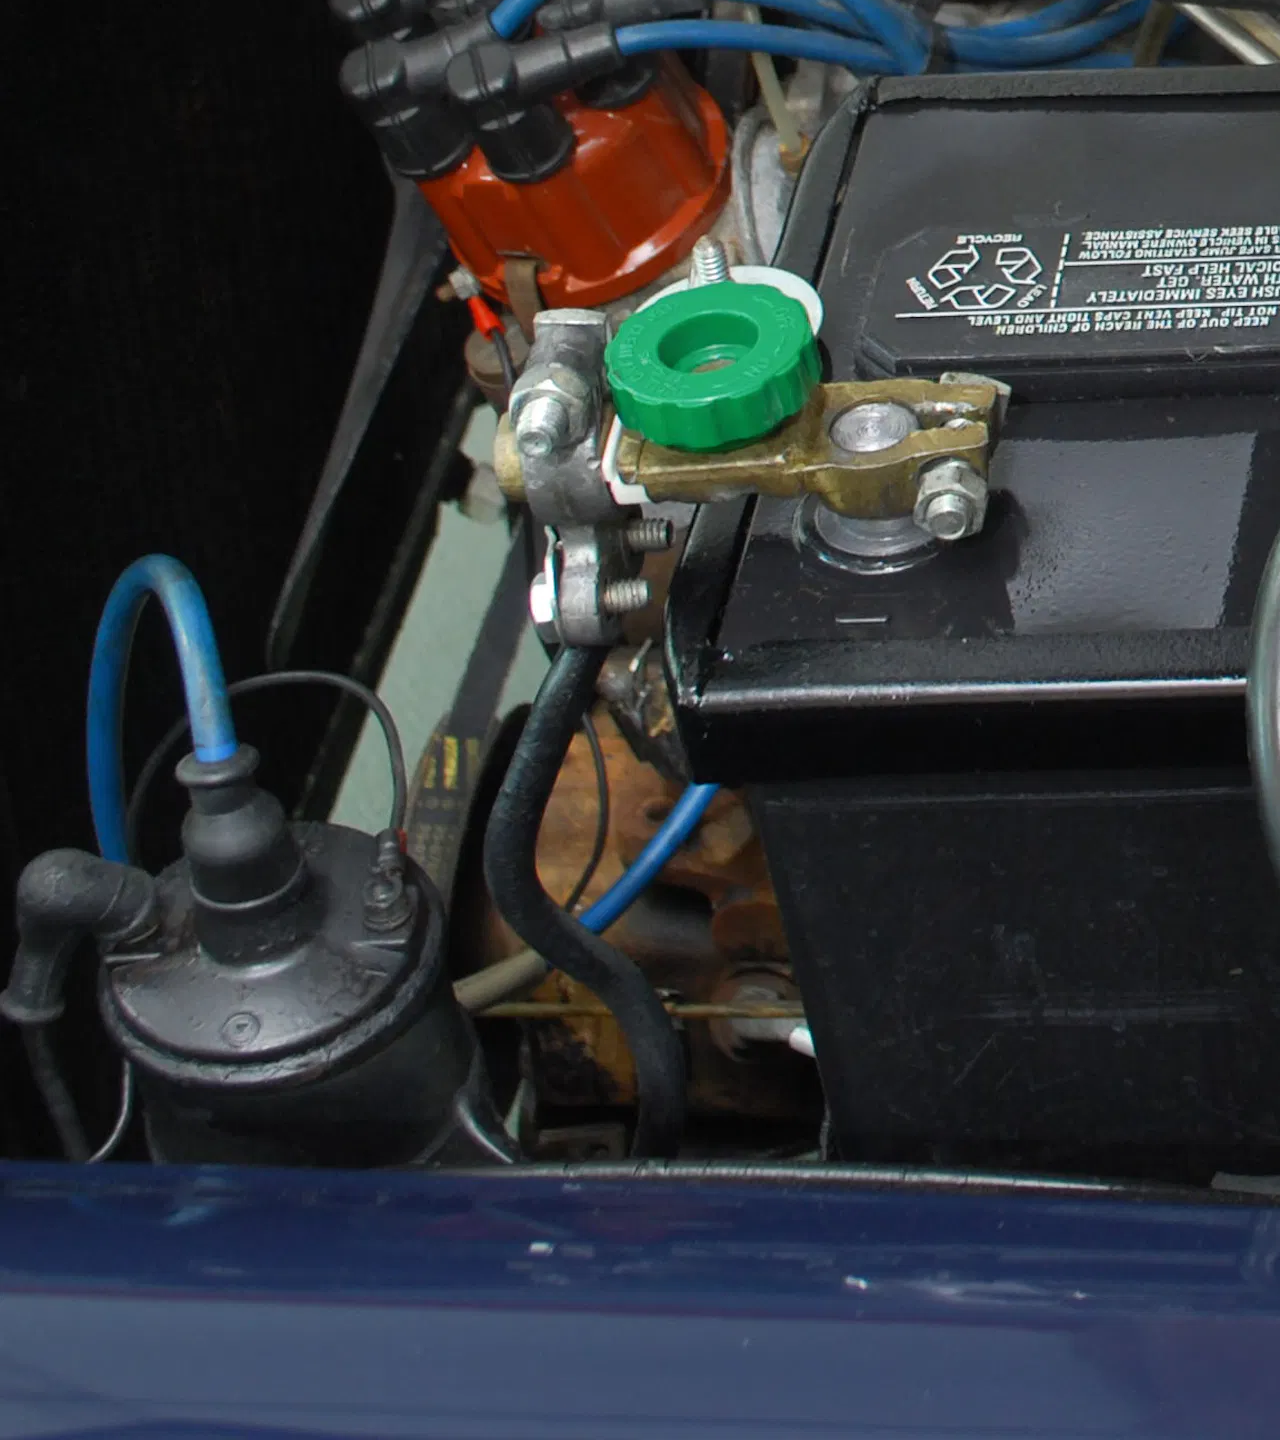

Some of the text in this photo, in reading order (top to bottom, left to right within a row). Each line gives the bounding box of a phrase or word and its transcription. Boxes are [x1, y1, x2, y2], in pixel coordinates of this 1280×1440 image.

[956, 234, 1022, 245] RECYCLE
[1079, 249, 1132, 261] FOLLOW
[1200, 246, 1237, 257] JUMP
[1142, 265, 1184, 277] FAST
[1188, 263, 1231, 276] HELP
[1157, 277, 1189, 288] GET
[1017, 283, 1047, 308] LEAD
[1087, 289, 1201, 304] IMMEDIATELY
[1206, 287, 1248, 300] EYES
[1095, 311, 1132, 322] CAPS
[1250, 306, 1277, 316] NOT
[968, 316, 1010, 326] LEVEL
[1016, 315, 1044, 325] AND
[1147, 320, 1172, 330] THE
[1178, 319, 1196, 329] OF
[1201, 318, 1230, 328] OUT
[1234, 316, 1269, 327] KEEP
[1072, 322, 1090, 333] OF
